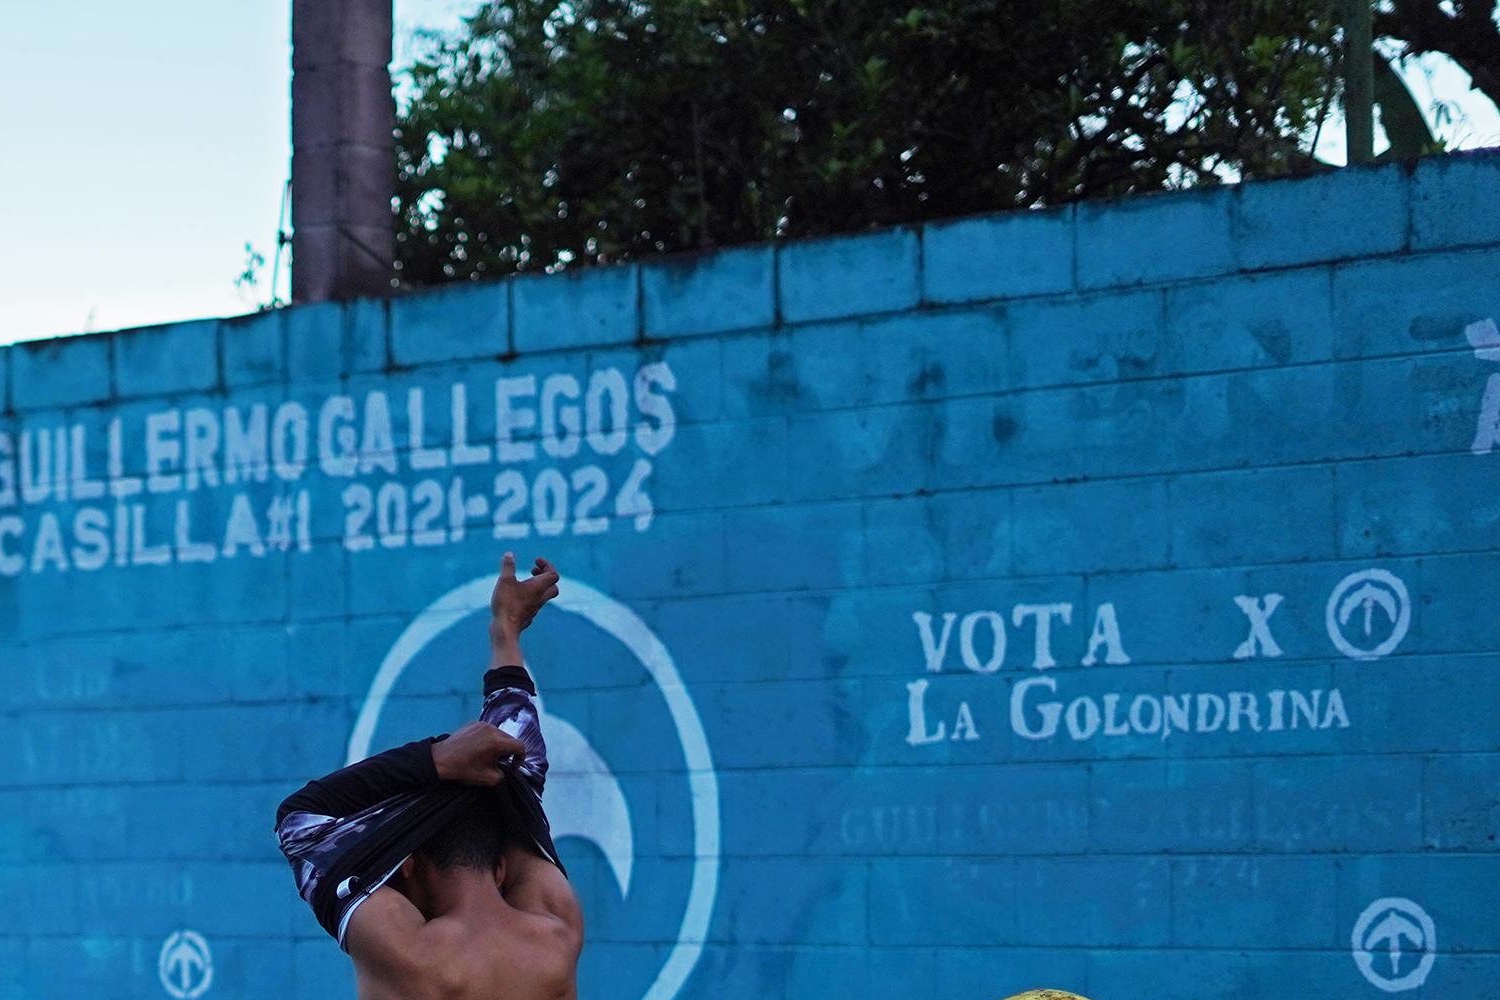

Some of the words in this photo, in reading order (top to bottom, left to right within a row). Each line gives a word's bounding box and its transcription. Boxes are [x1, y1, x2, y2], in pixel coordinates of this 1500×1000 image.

[319, 362, 677, 475] GALLEGOS
[343, 455, 655, 552] 2021-2024
[912, 602, 1131, 673] VOTA
[1233, 593, 1285, 659] X
[1010, 676, 1350, 740] GOLONDRINA
